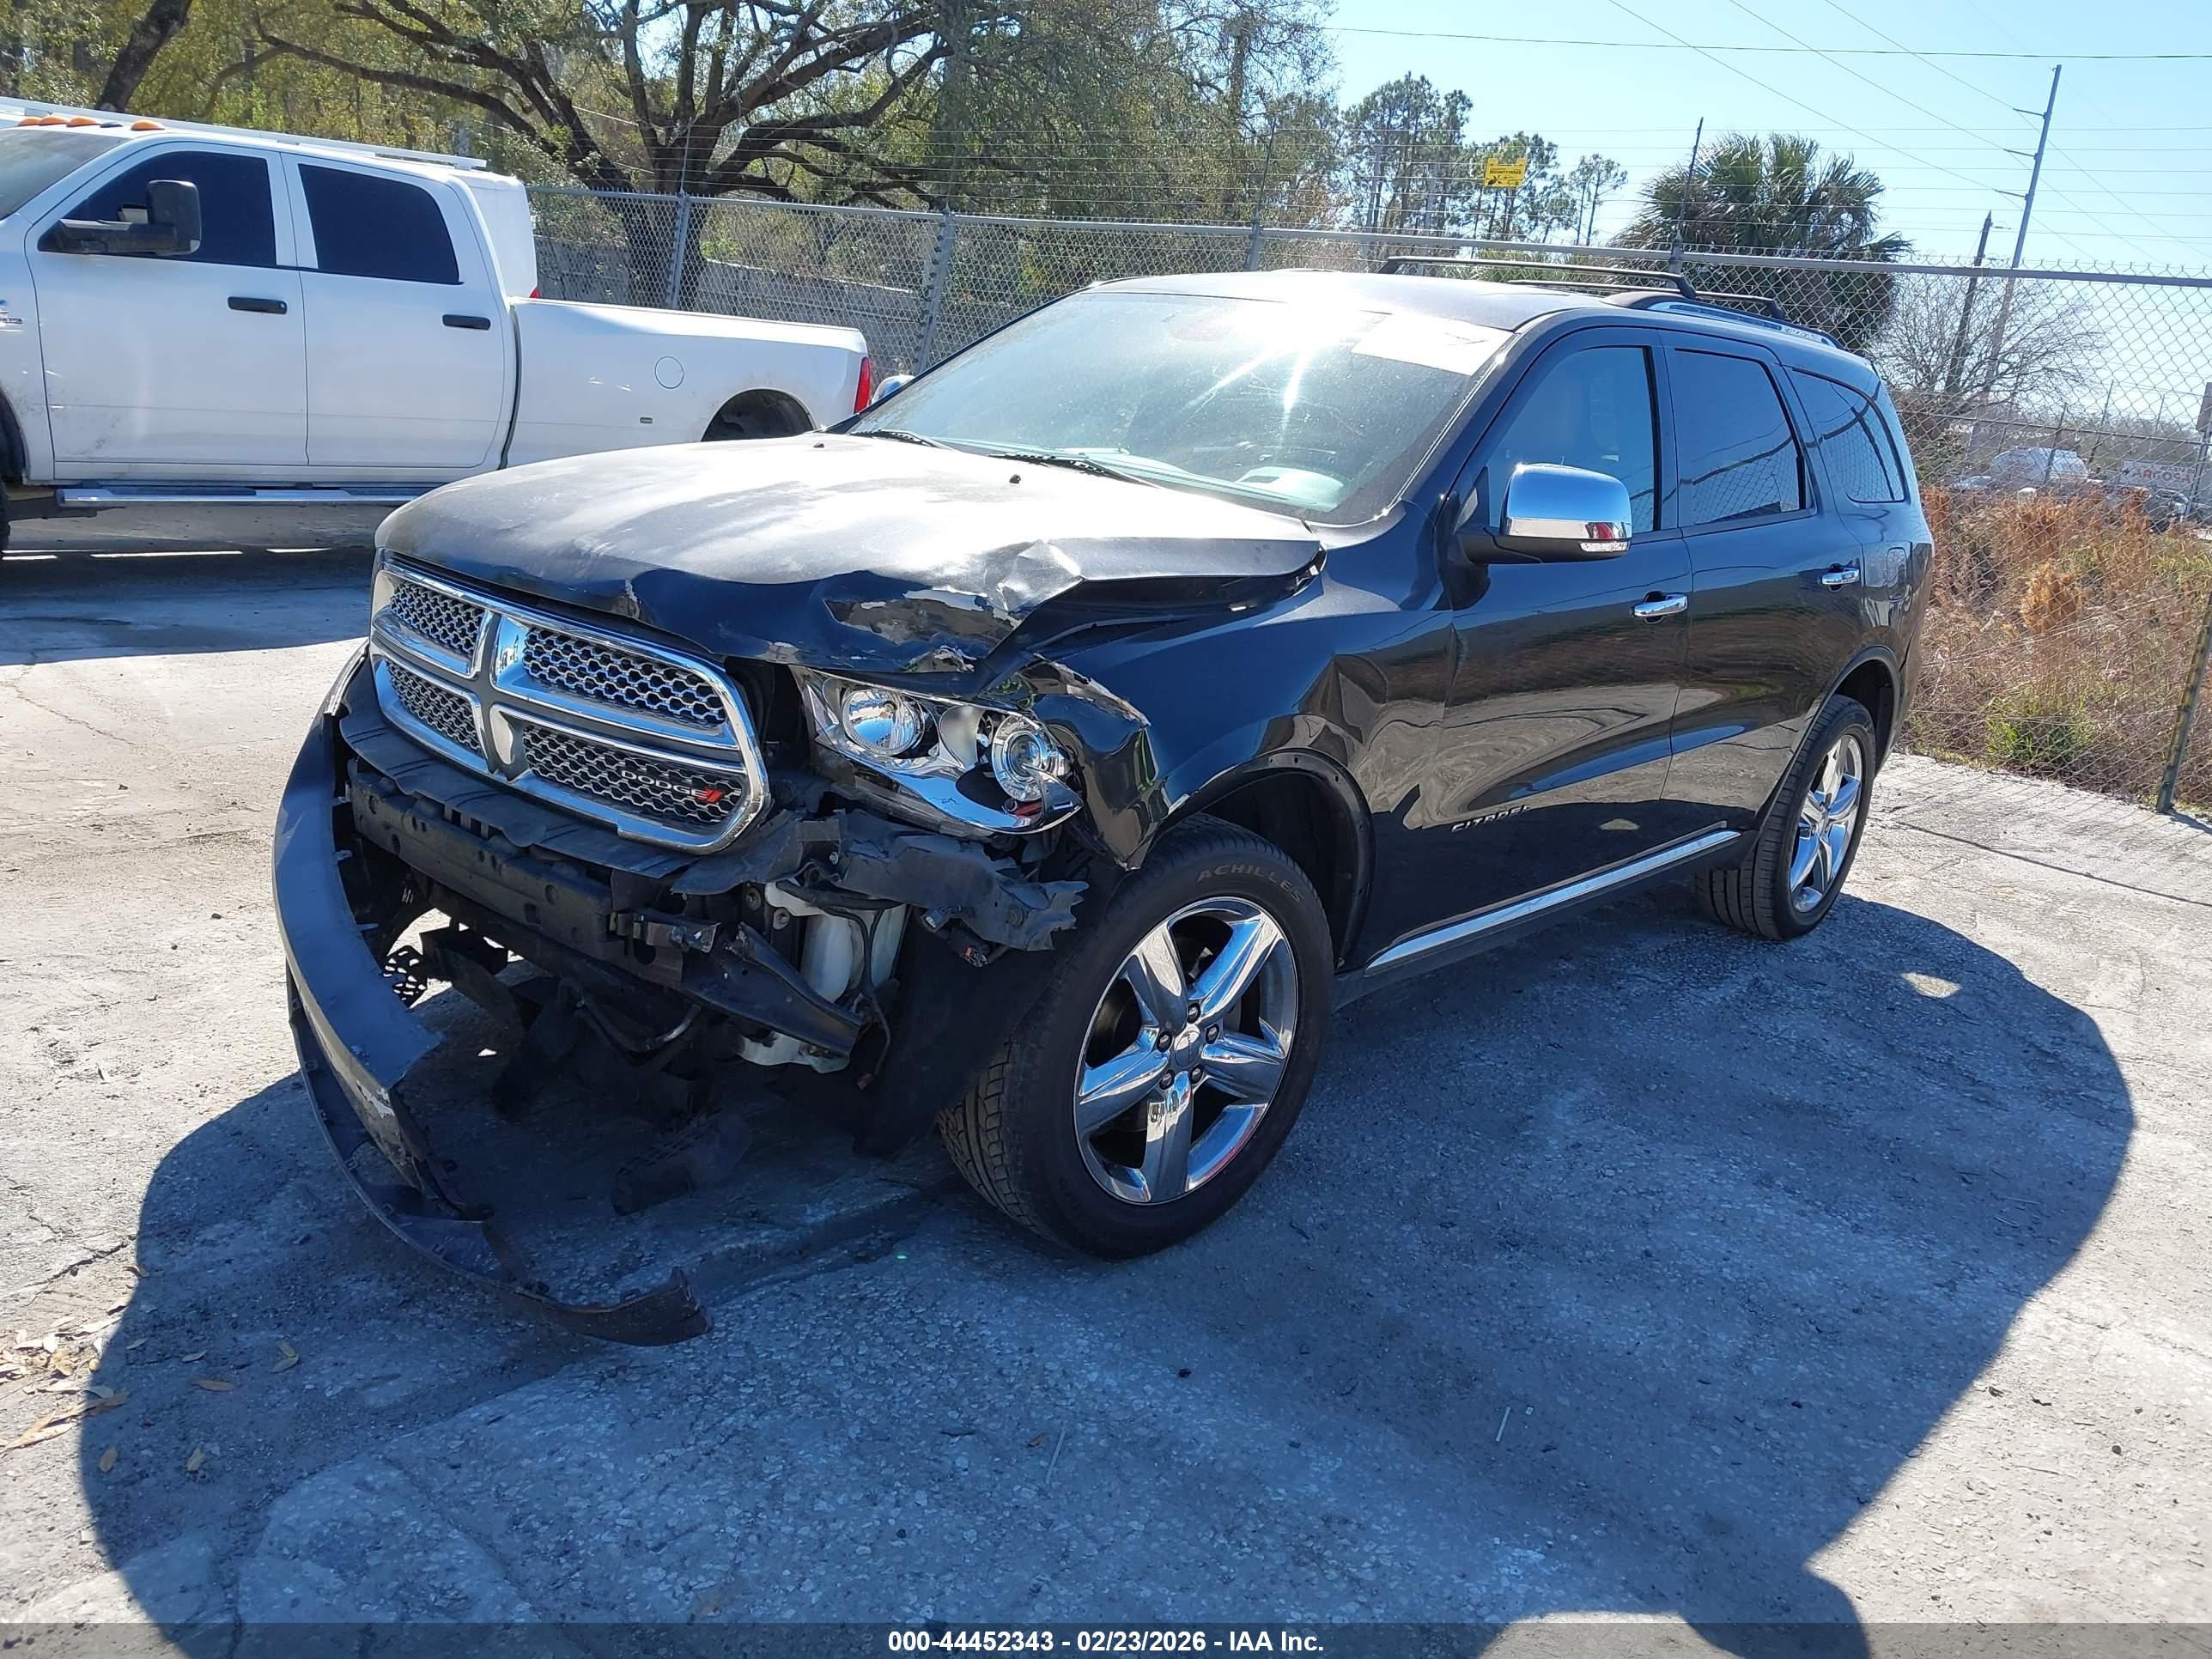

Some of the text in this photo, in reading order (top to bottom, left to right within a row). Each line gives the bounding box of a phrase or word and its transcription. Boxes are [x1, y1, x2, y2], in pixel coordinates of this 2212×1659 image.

[621, 769, 708, 799] DODGE
[1450, 805, 1530, 833] CITADEL
[1196, 863, 1304, 903] ACHILLES
